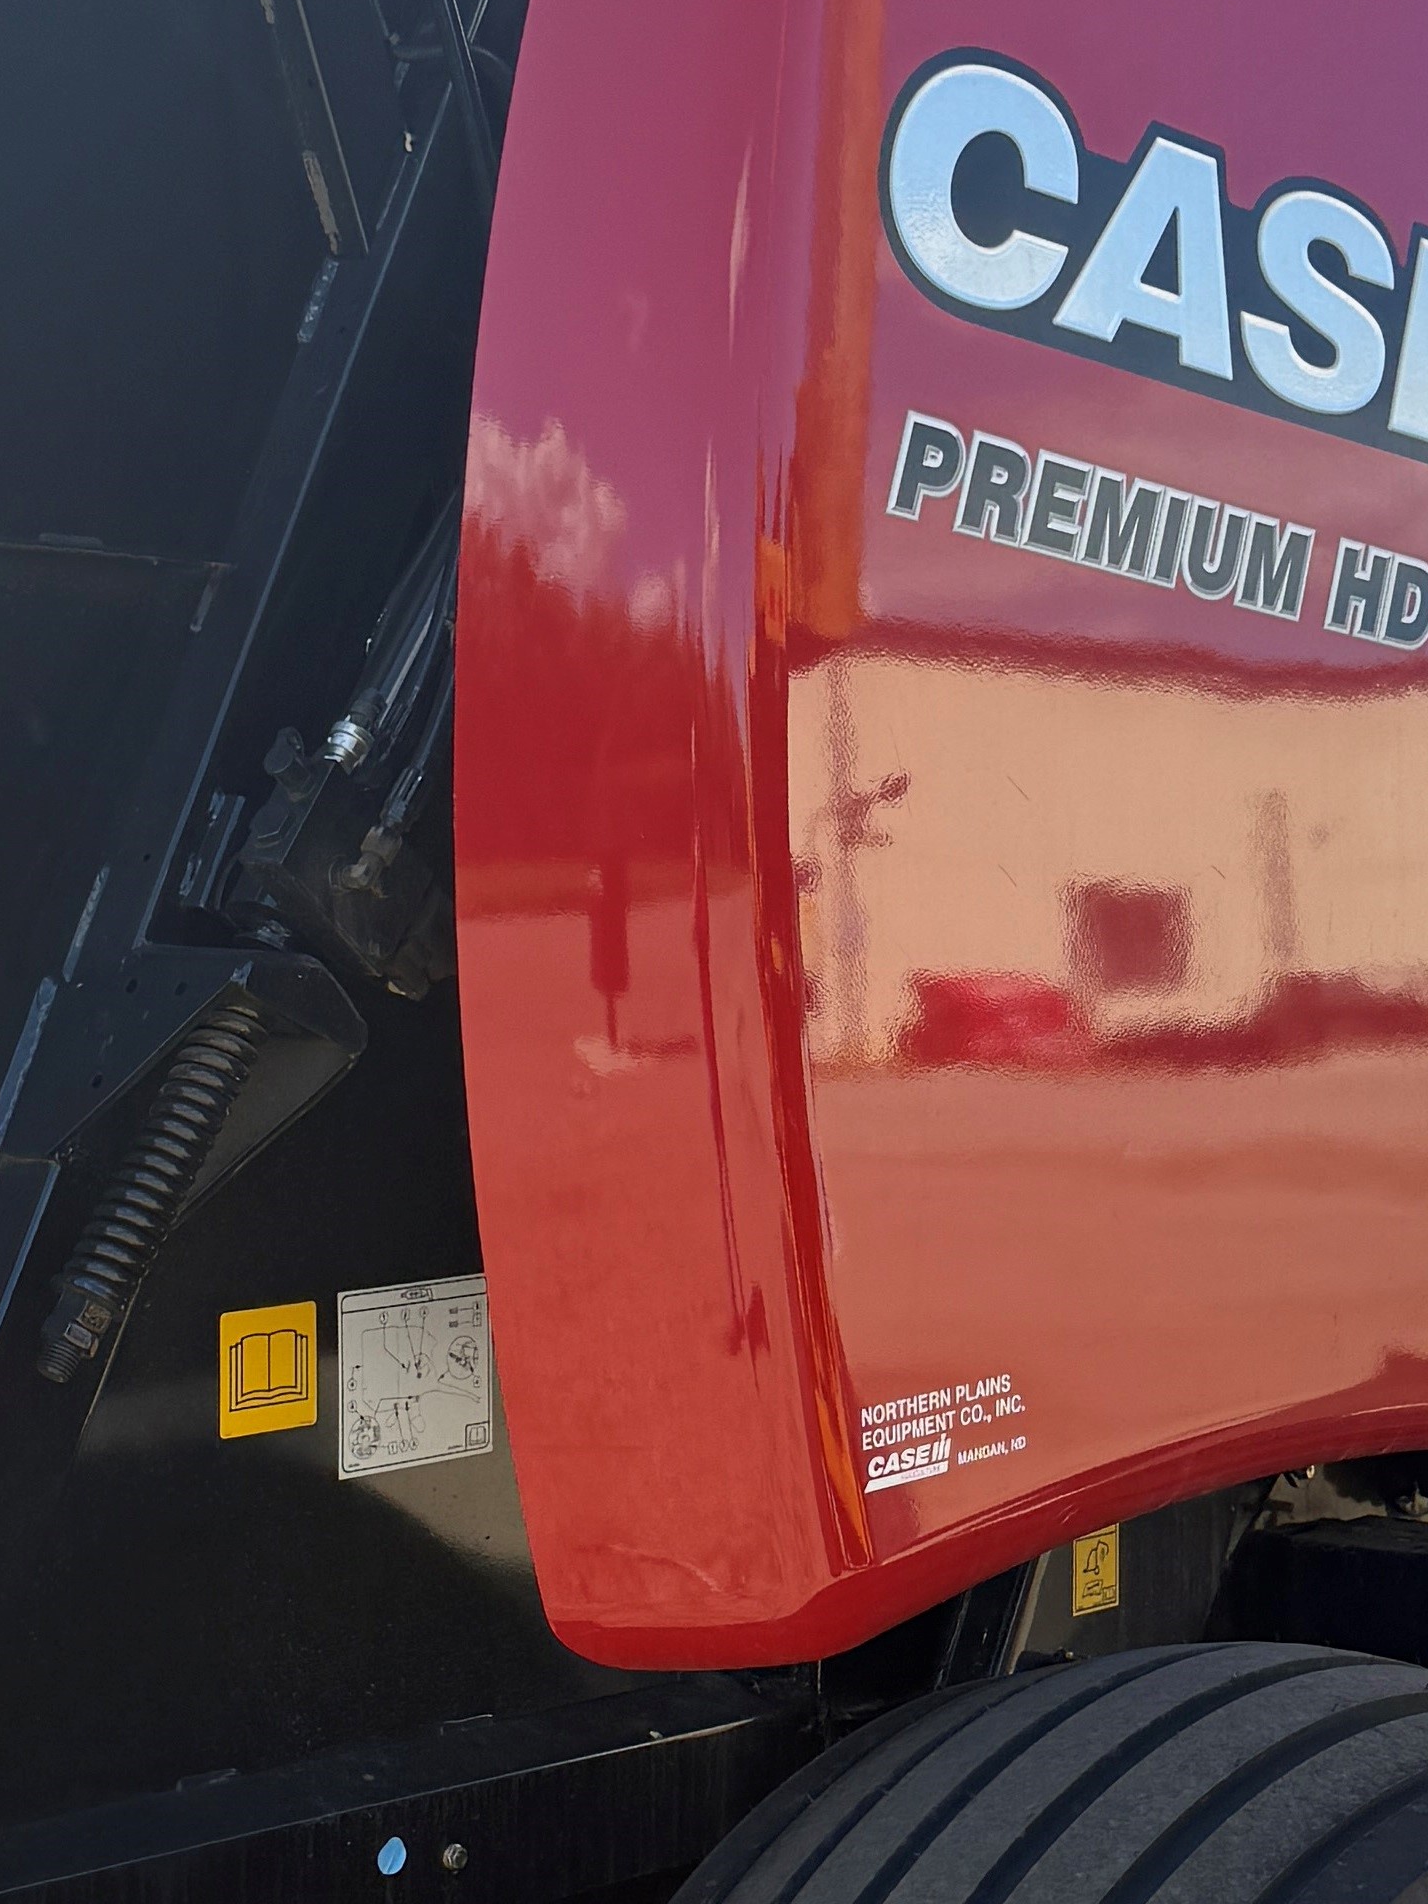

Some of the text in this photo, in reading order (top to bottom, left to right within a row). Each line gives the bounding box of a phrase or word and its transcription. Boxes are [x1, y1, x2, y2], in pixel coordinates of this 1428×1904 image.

[884, 410, 1317, 623] PREMIUM
[860, 1374, 1012, 1428] NORTHERN PLAINS
[862, 1394, 1027, 1452] EQUIPMENT CO., INC.
[867, 1442, 932, 1479] CASE
[957, 1440, 1009, 1466] MANDAN,
